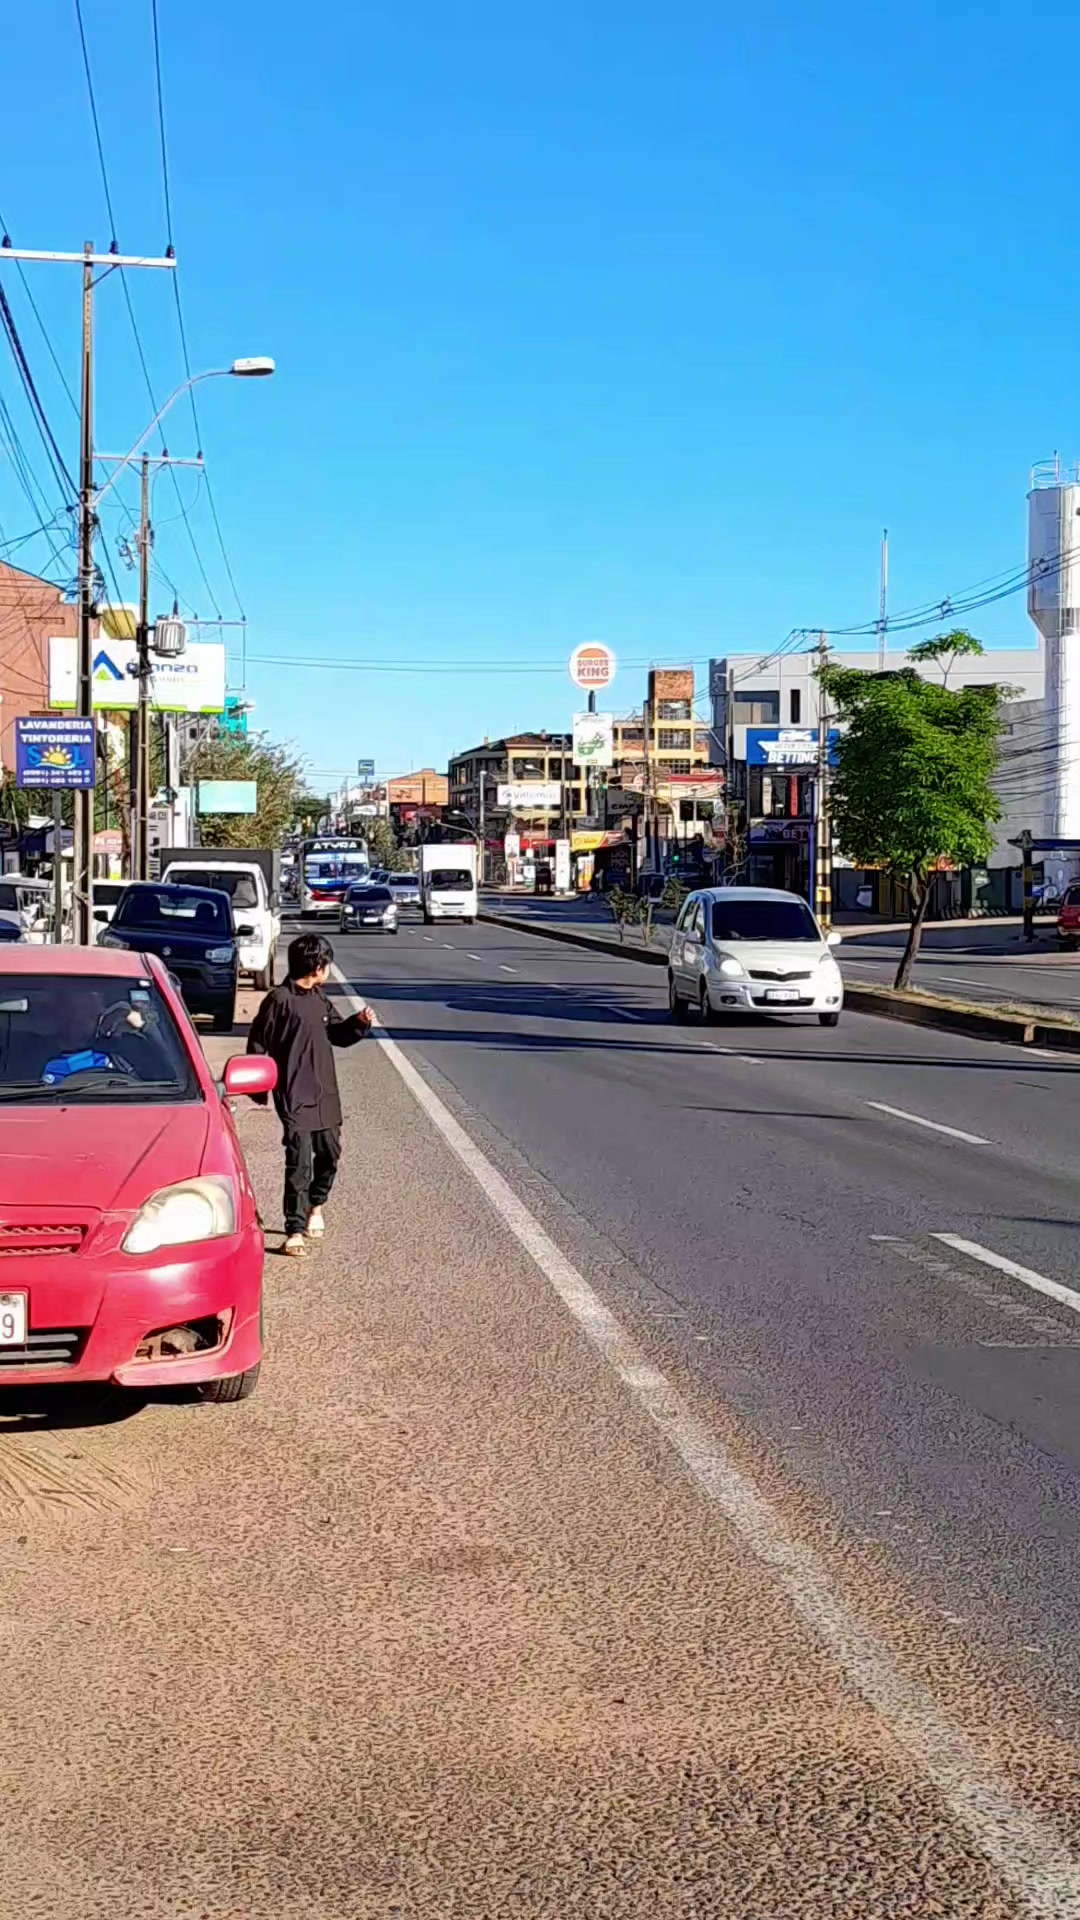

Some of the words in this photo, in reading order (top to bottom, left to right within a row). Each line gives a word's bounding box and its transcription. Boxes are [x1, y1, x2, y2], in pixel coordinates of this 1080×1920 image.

[577, 667, 609, 677] KING
[19, 720, 92, 730] LAVANDERIA
[20, 734, 92, 744] TINTORERIA
[313, 841, 358, 850] ATYRA
